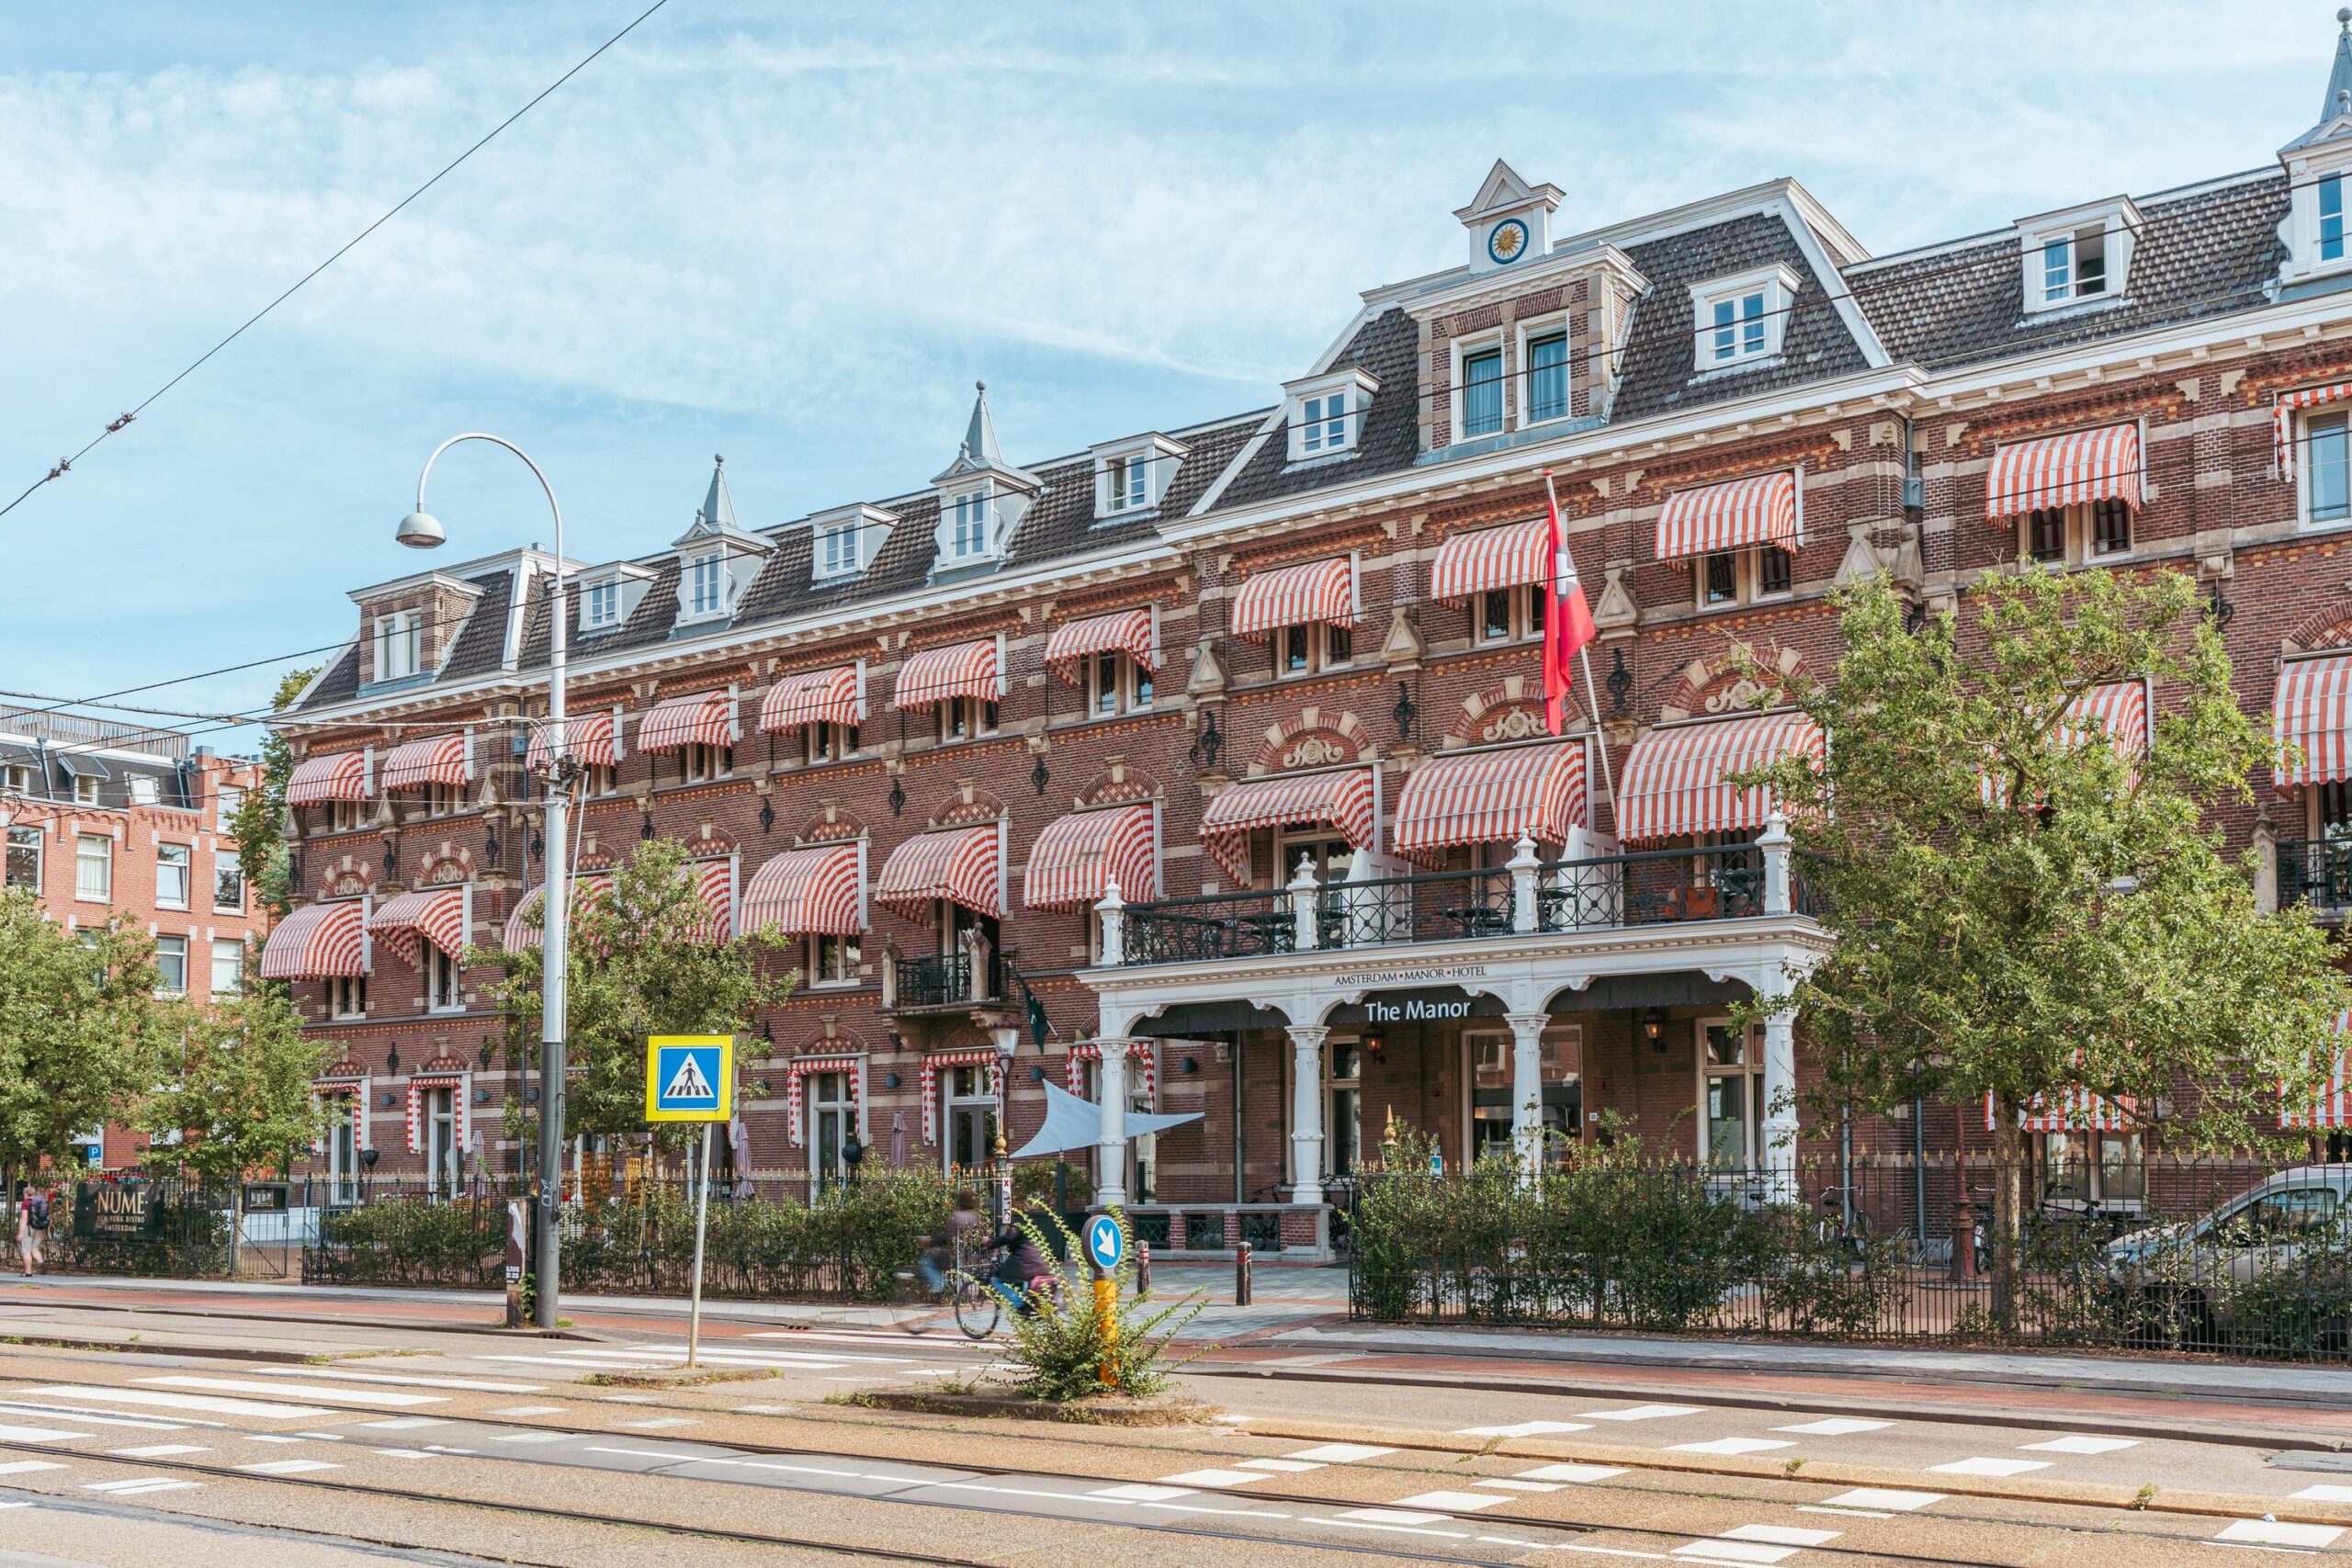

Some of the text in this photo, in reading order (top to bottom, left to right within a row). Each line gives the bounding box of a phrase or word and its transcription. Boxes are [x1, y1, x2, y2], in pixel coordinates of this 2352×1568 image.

[1335, 965, 1487, 986] AMSTERDAM MANOR HOTEL
[1364, 999, 1471, 1021] The Manor
[97, 1191, 145, 1213] NUME
[96, 1214, 145, 1224] NEW YORK BISTRO
